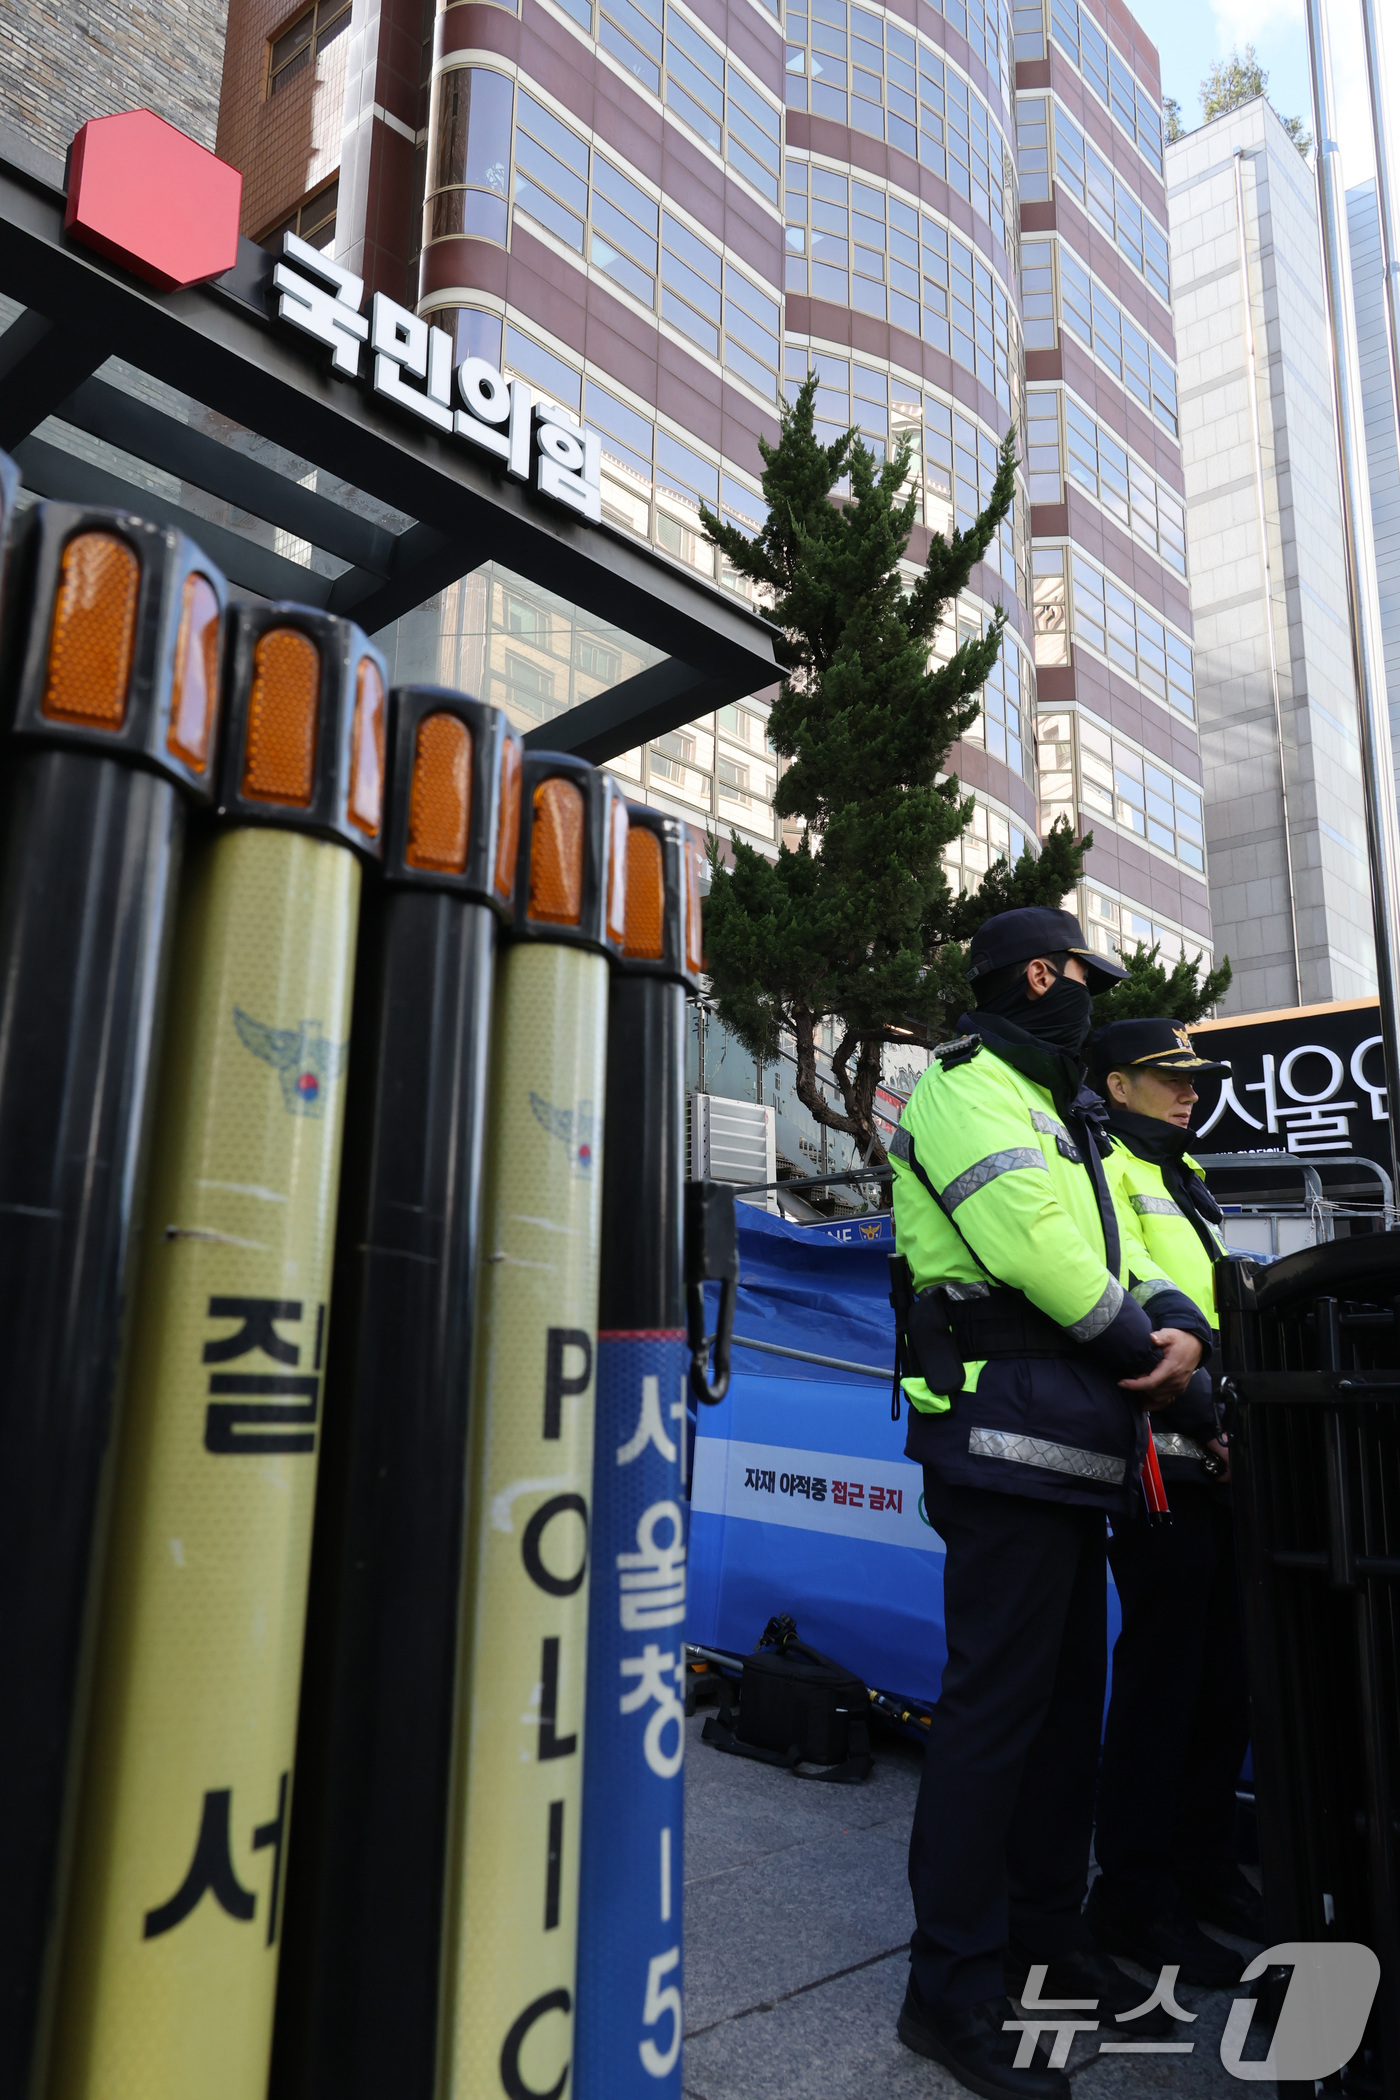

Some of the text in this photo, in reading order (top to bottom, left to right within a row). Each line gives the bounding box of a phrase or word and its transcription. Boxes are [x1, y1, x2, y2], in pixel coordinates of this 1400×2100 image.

[273, 231, 601, 525] 국민의힘
[745, 1468, 903, 1514] 자재 야적중 접근 금지
